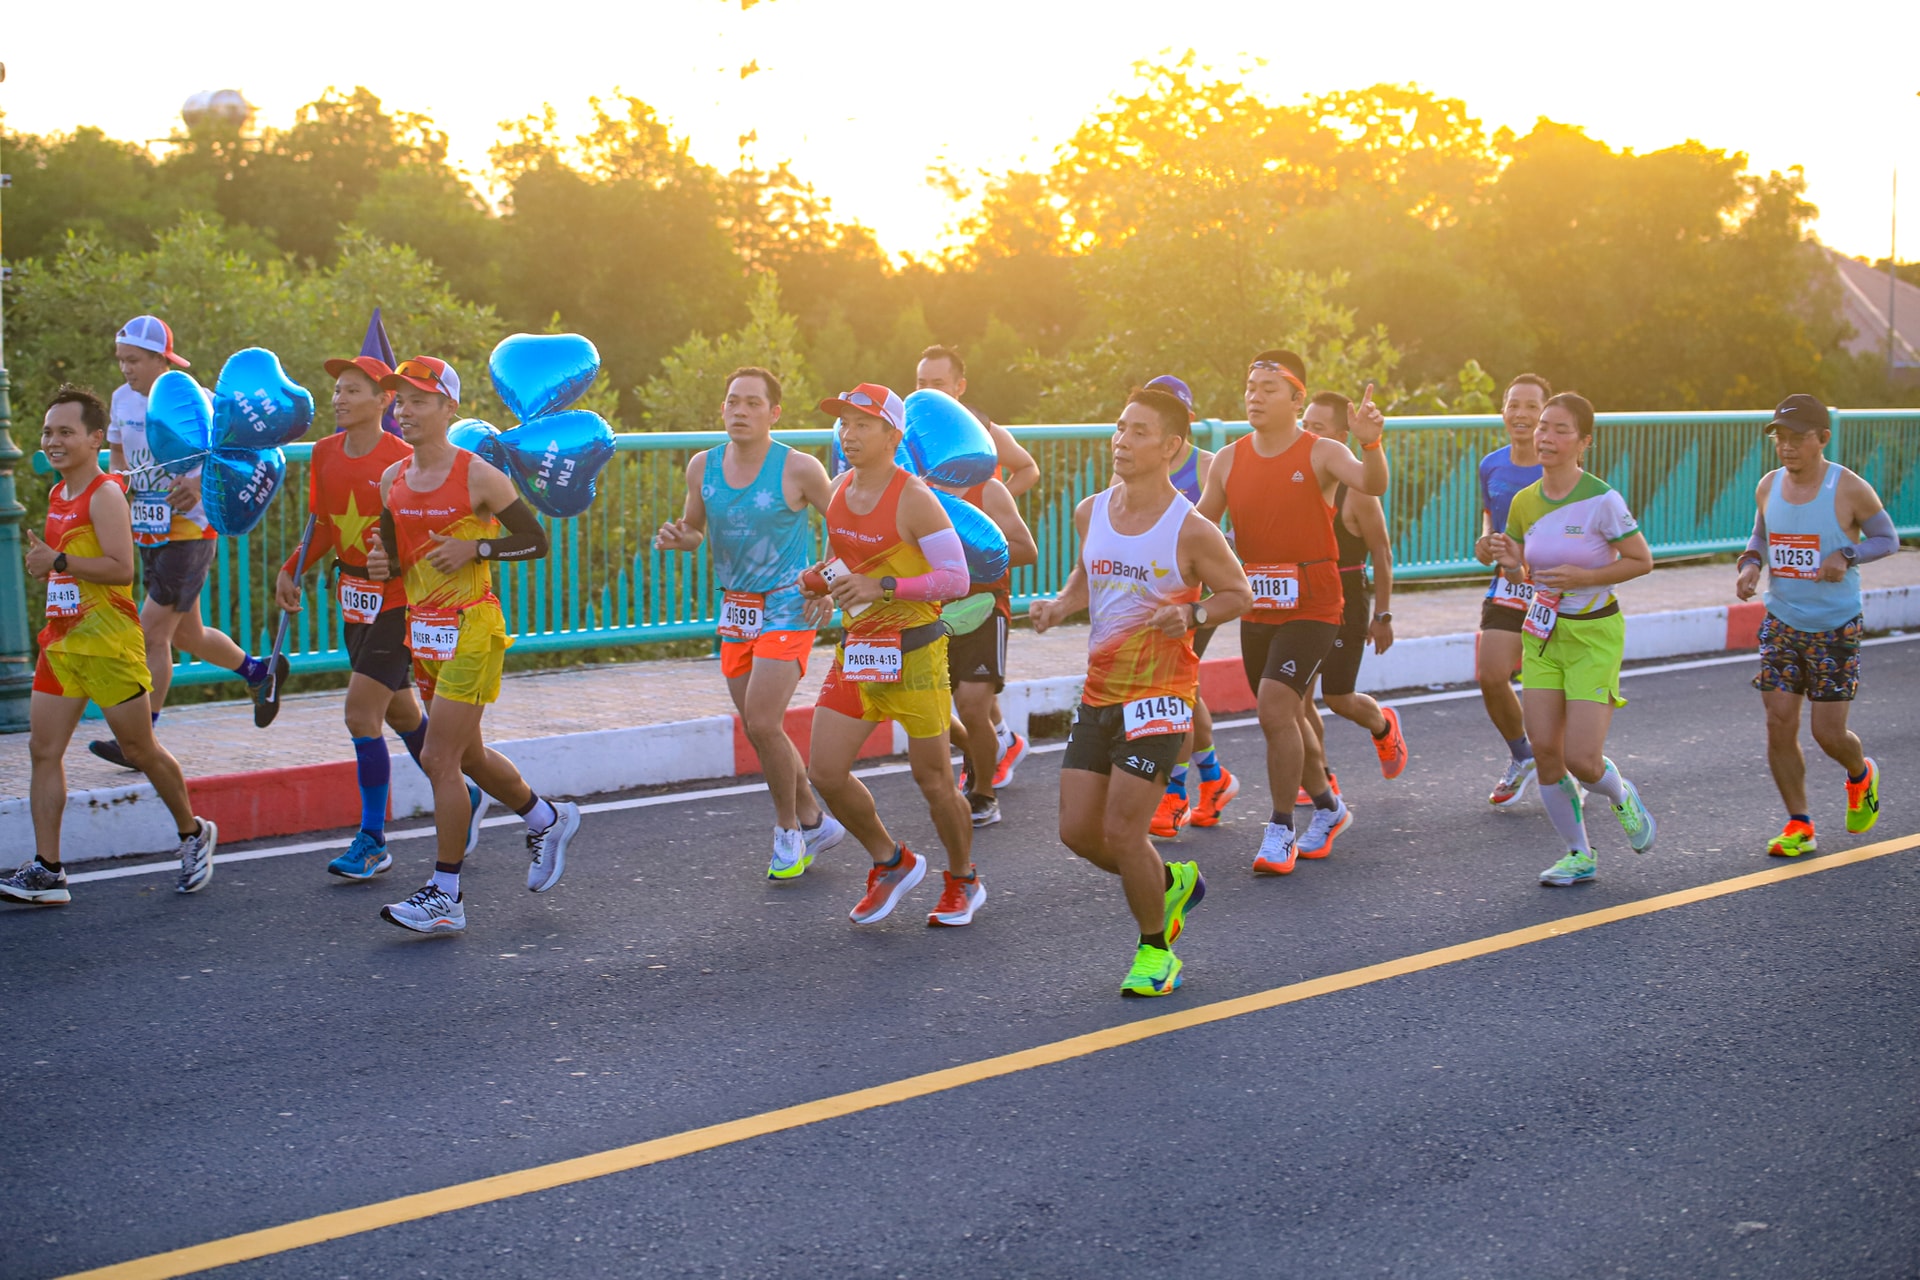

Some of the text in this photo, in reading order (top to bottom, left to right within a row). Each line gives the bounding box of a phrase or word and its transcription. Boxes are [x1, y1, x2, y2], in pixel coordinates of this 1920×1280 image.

[233, 390, 266, 432] 4H15
[254, 388, 277, 415] FM
[534, 439, 559, 490] 4H15
[556, 458, 576, 487] FM
[238, 459, 267, 503] 4H15
[255, 477, 274, 504] FM
[133, 505, 164, 521] 21548
[1775, 549, 1814, 566] 41253
[1091, 559, 1150, 582] HDBank
[1252, 579, 1289, 596] 41181
[344, 590, 378, 611] 41360
[726, 606, 757, 626] 41599
[848, 654, 898, 666] PACER-4:15
[1141, 758, 1156, 774] T8
